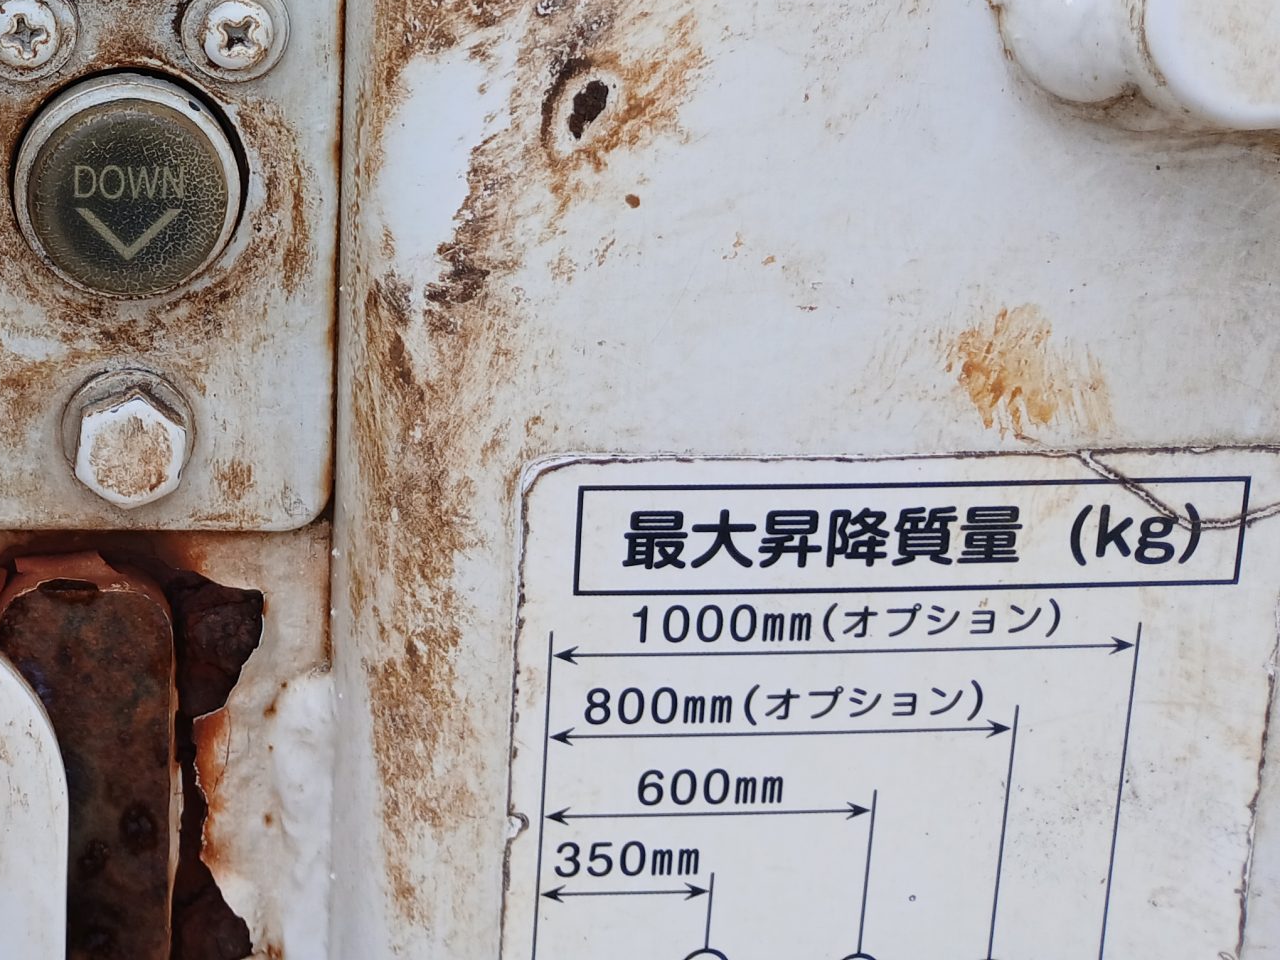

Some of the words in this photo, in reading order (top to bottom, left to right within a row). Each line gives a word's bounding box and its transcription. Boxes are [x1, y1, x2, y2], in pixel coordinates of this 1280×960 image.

[73, 164, 187, 201] DOWN
[621, 504, 1023, 571] 最大昇降質量
[1069, 502, 1202, 567] (kg)
[636, 768, 785, 807] 600mm
[553, 840, 701, 879] 350mm
